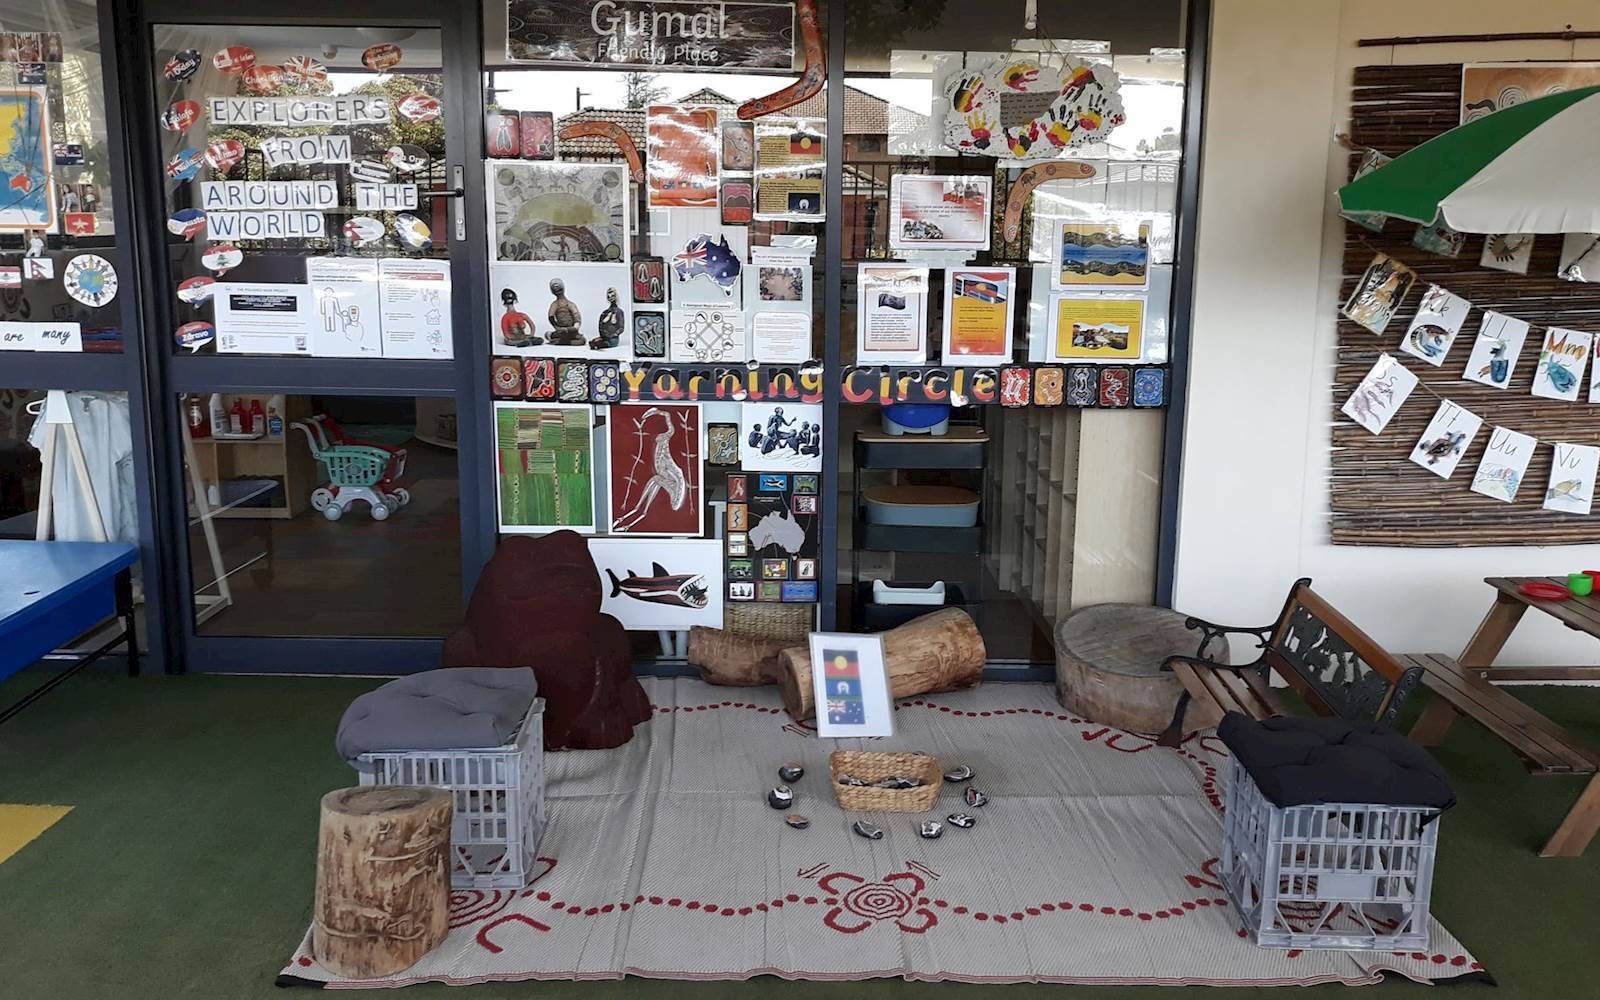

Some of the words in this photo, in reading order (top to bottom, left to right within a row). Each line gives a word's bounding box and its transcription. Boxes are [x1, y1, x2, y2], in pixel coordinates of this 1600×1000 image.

[591, 1, 730, 39] Gumal
[598, 42, 666, 64] Friendly
[674, 44, 719, 62] Place
[214, 99, 386, 121] EXPLORERS
[265, 139, 349, 162] FROM
[208, 185, 333, 205] AROUND
[360, 187, 415, 206] THE
[211, 214, 320, 236] WORLD
[4, 333, 24, 342] are
[42, 330, 71, 345] many
[1546, 330, 1586, 360] Mm
[619, 359, 824, 403] Yarning
[841, 364, 998, 407] Circle
[1437, 403, 1462, 427] Tt
[1490, 432, 1518, 456] Uu
